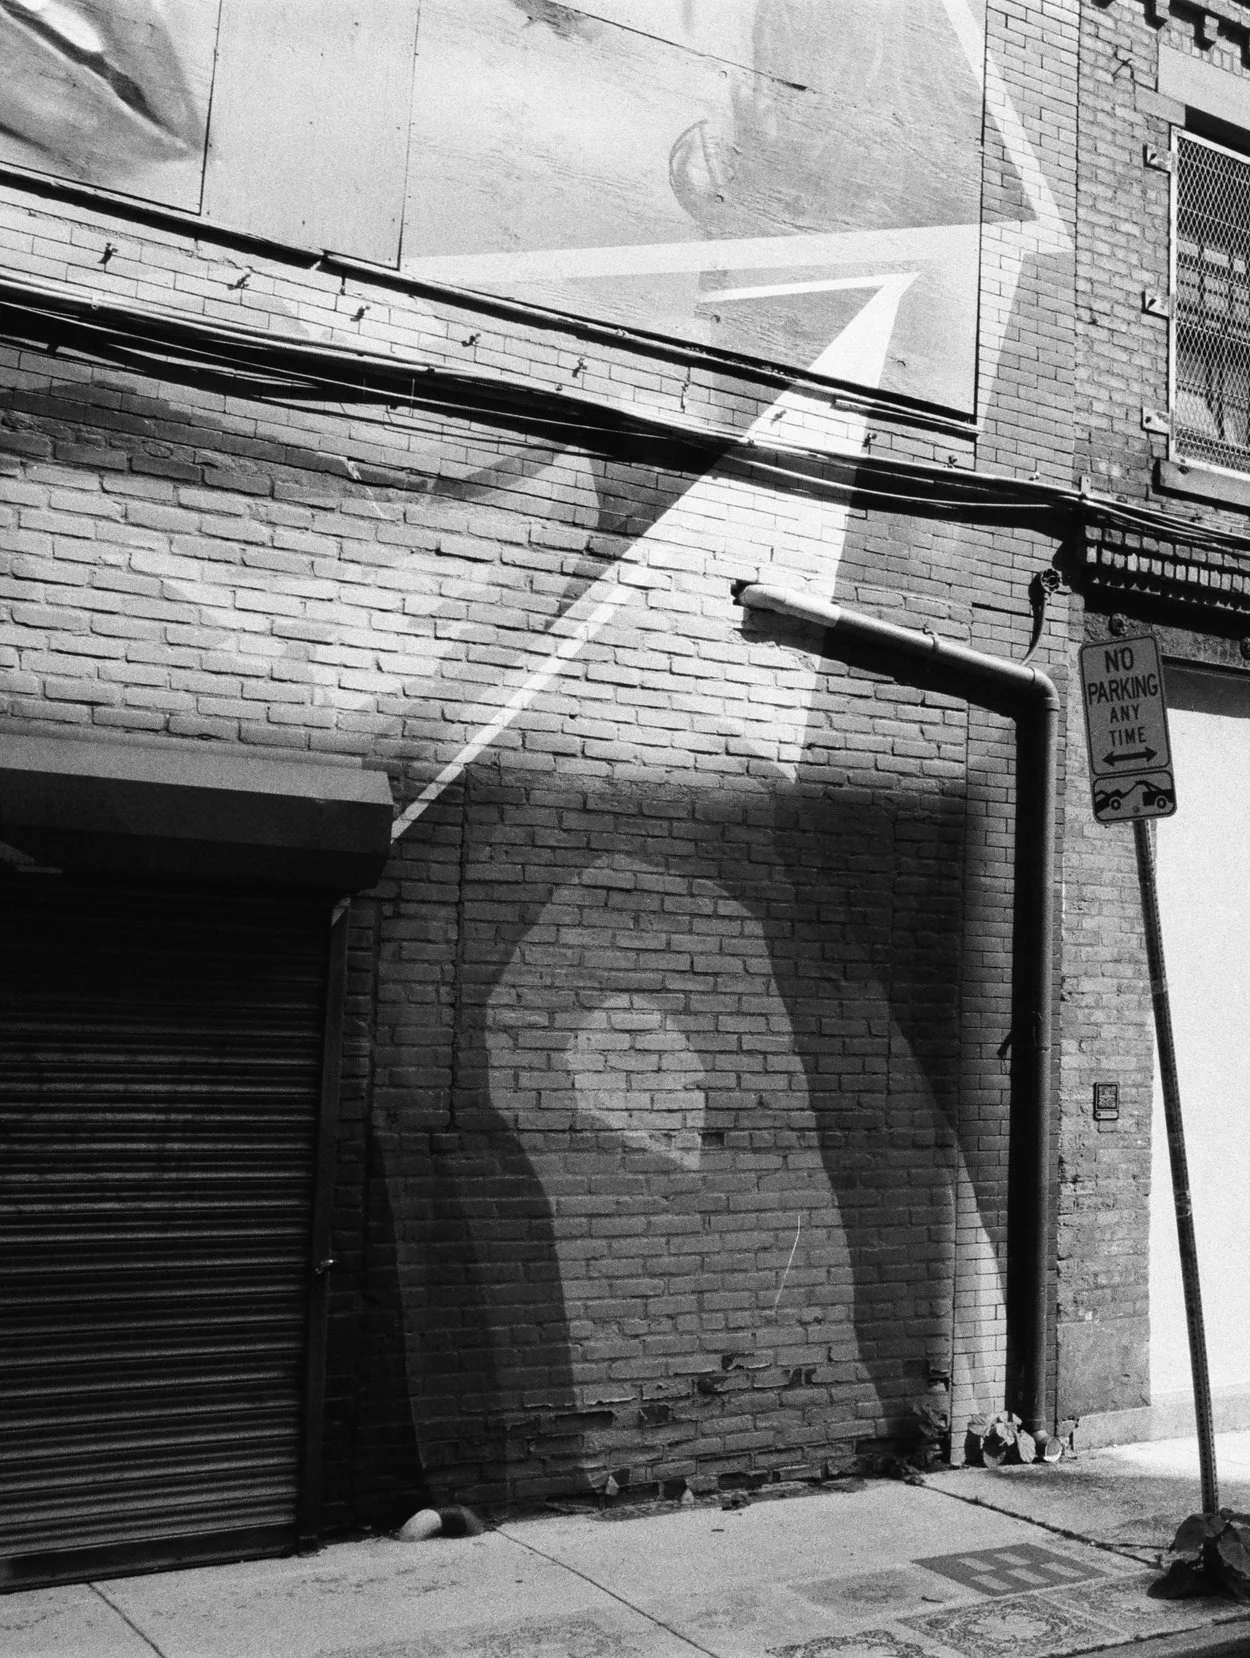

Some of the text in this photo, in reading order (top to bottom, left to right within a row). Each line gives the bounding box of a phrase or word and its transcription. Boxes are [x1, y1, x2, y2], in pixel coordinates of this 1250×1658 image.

[1105, 647, 1134, 673] NO
[1087, 673, 1158, 705] PARKING
[1110, 704, 1139, 723] ANY
[1109, 726, 1146, 747] TIME
